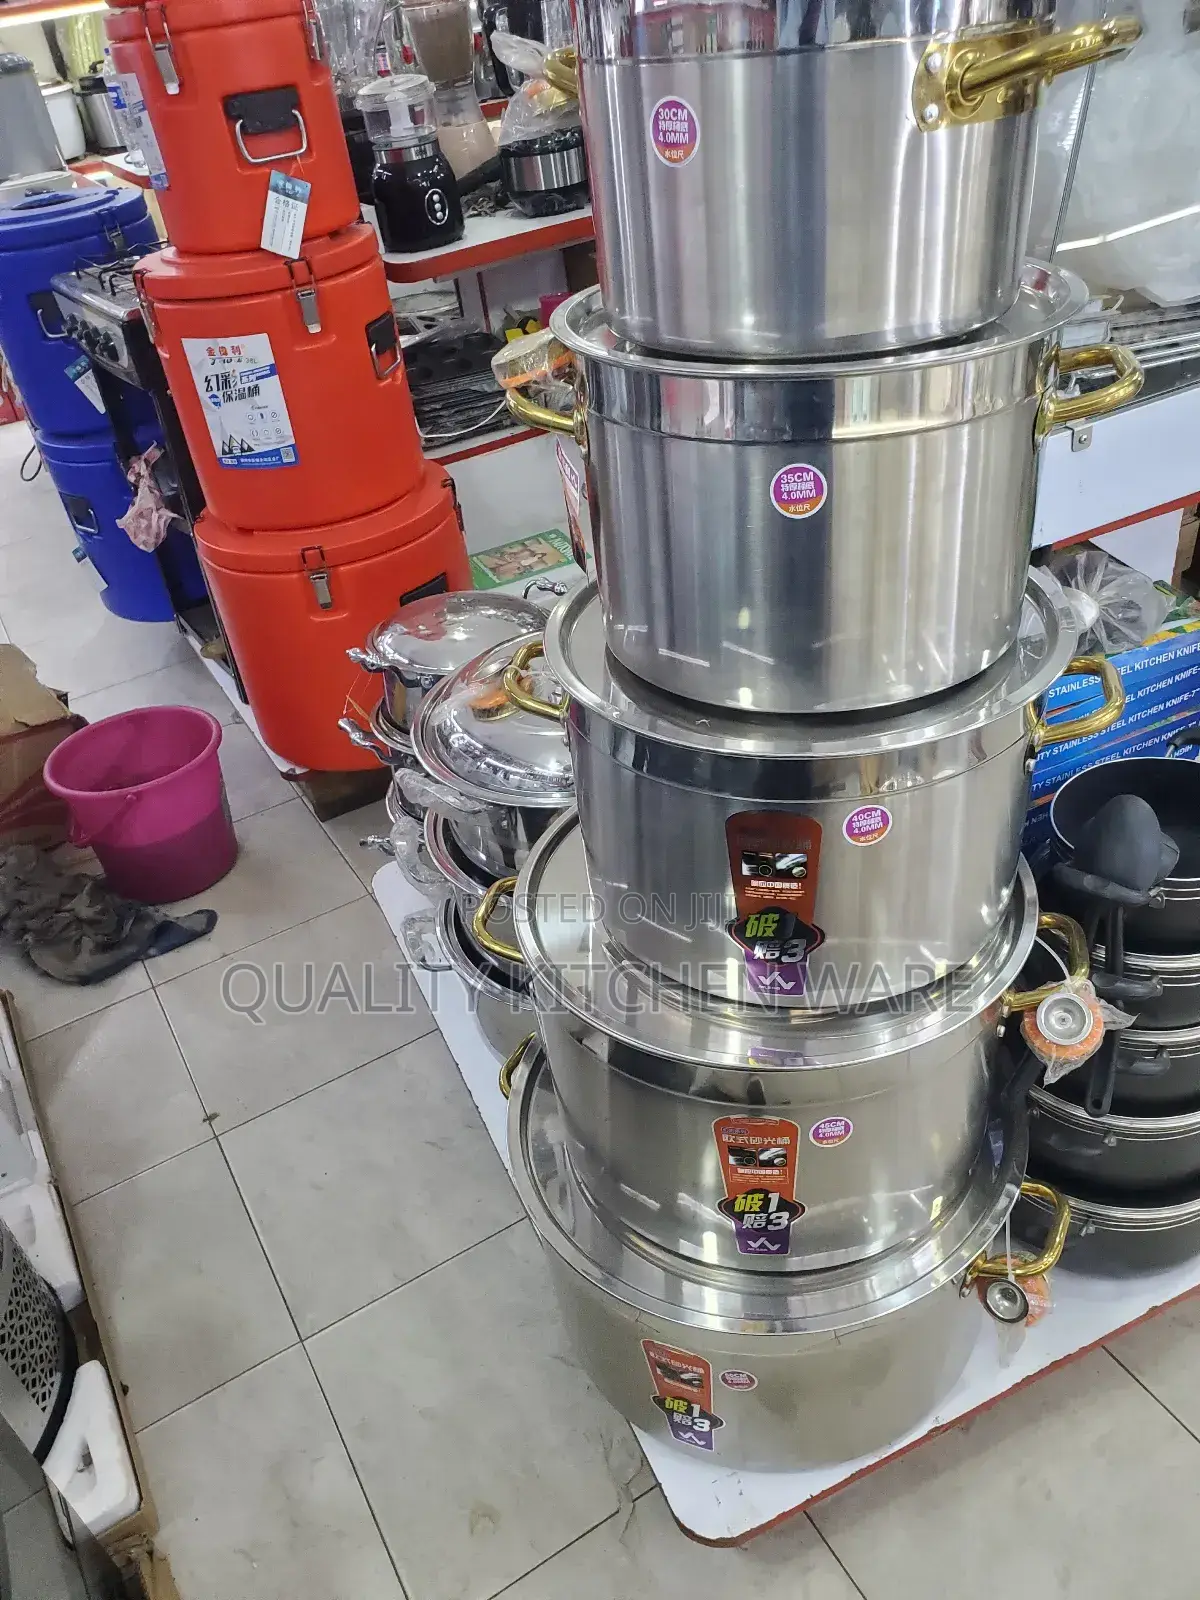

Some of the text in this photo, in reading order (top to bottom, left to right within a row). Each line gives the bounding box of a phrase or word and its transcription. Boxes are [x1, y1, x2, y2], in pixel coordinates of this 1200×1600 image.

[658, 108, 688, 121] 30CM
[658, 131, 689, 144] 4.0MM
[204, 369, 238, 393] 幻彩
[222, 384, 260, 404] 保温桶
[780, 471, 814, 484] 35CM
[781, 489, 816, 500] 4.0MM
[789, 503, 811, 512] 水位尺
[1048, 675, 1101, 698] STAINLESS
[1134, 651, 1175, 671] KITCHEN
[1137, 676, 1174, 698] KITCHEN
[1128, 703, 1165, 724] KITCHEN
[1122, 736, 1160, 756] KITCHEN
[852, 809, 882, 822] 40CM
[853, 821, 884, 834] 4.0MM
[734, 1193, 780, 1213] 破1
[742, 1211, 790, 1230] 赔3
